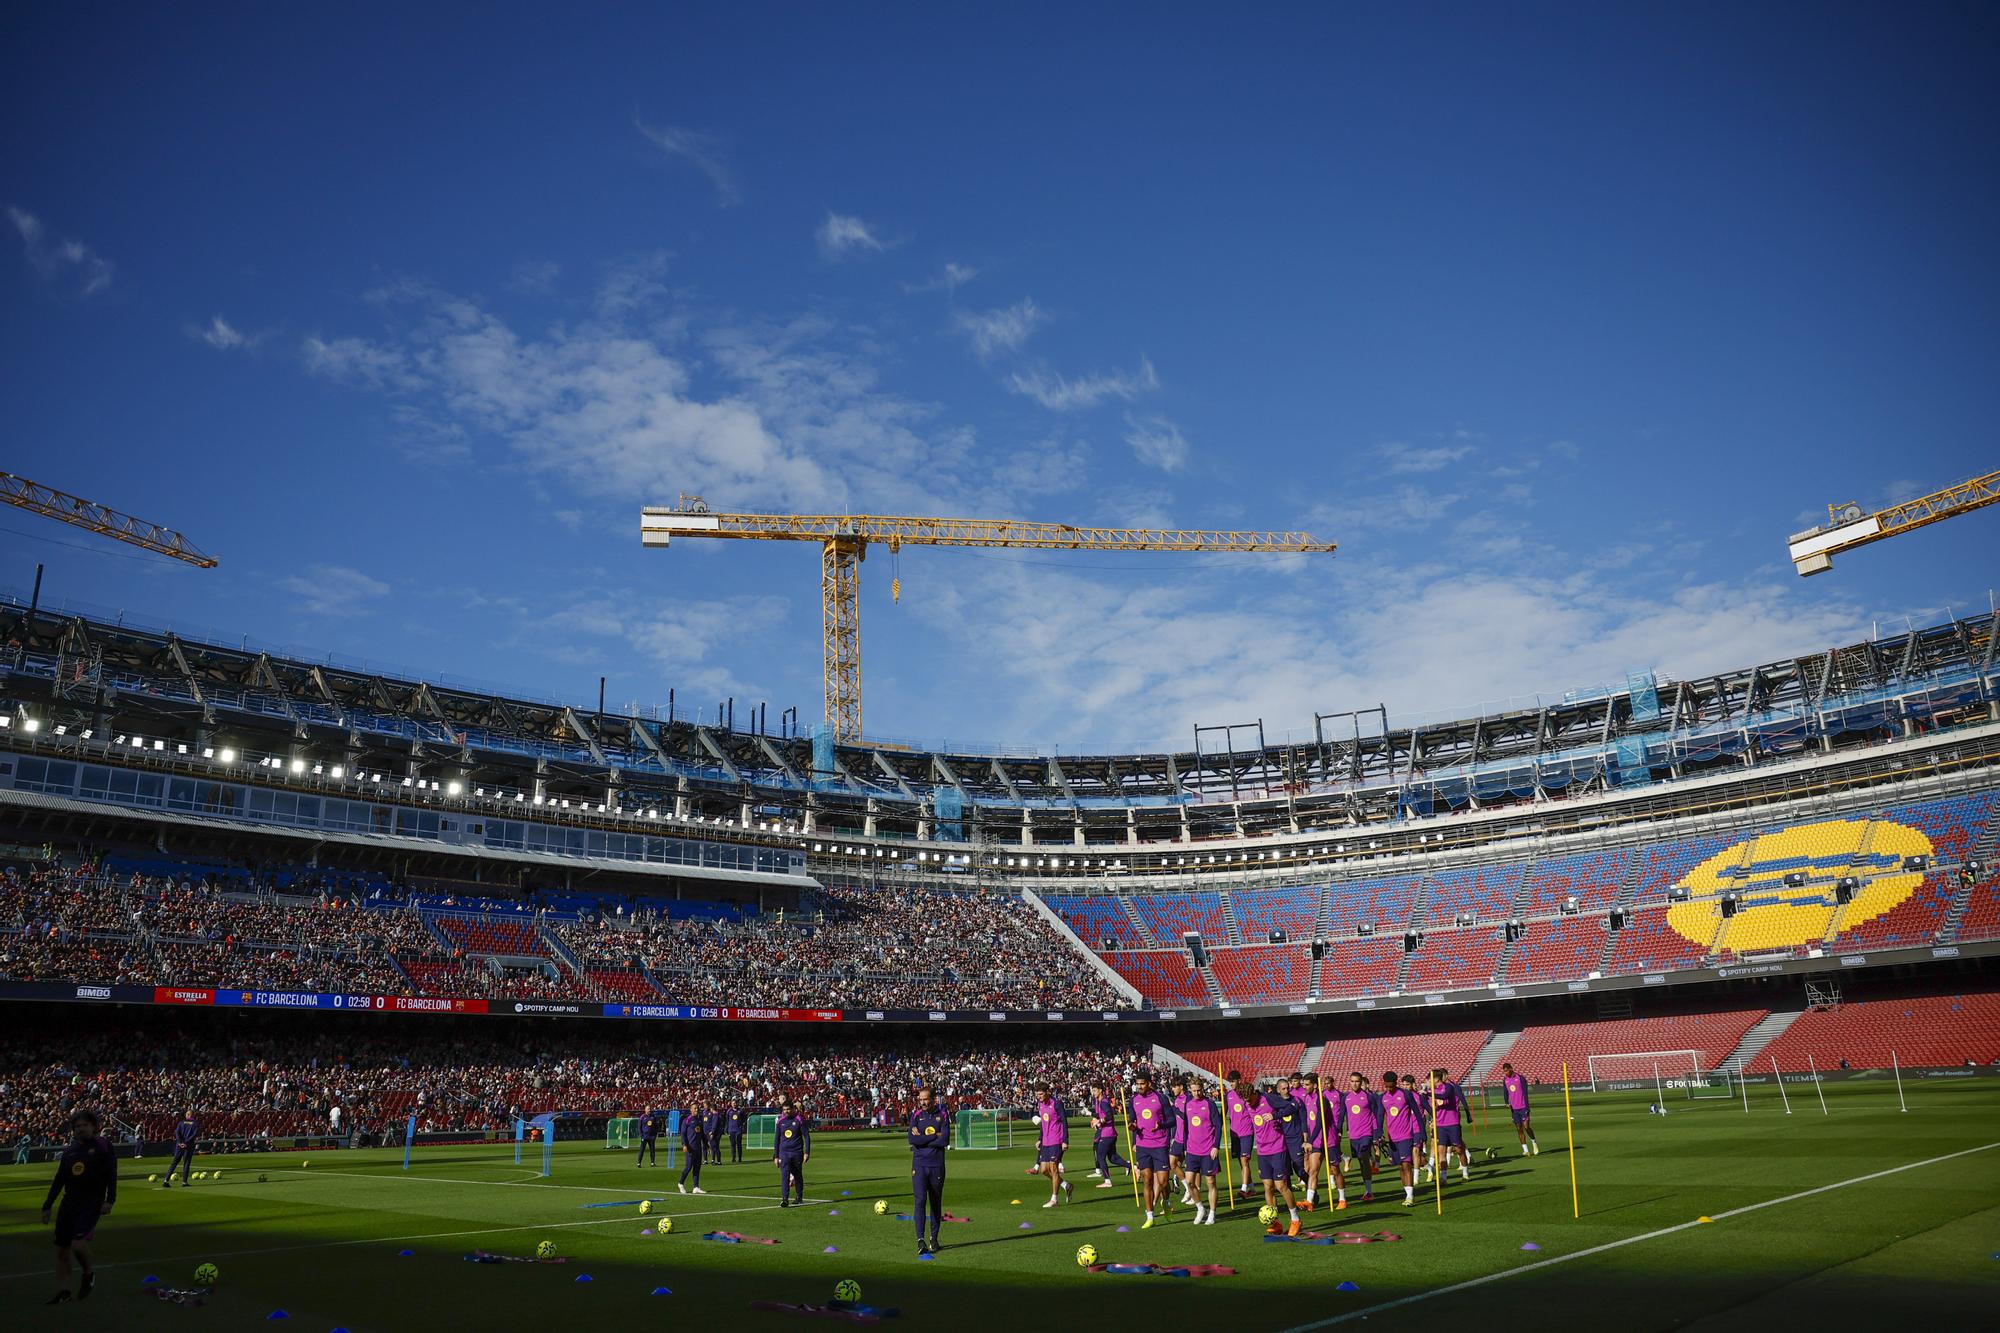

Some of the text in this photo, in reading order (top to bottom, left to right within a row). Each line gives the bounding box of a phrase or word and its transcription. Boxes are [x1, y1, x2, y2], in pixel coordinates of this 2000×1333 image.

[76, 987, 111, 998] BIMBO
[256, 993, 451, 1010] FC BARCELONA 0 02:58 0 FC BARCELONA
[633, 1006, 779, 1018] FC BARCELONA 0 02:58 0 FC BARCELONA
